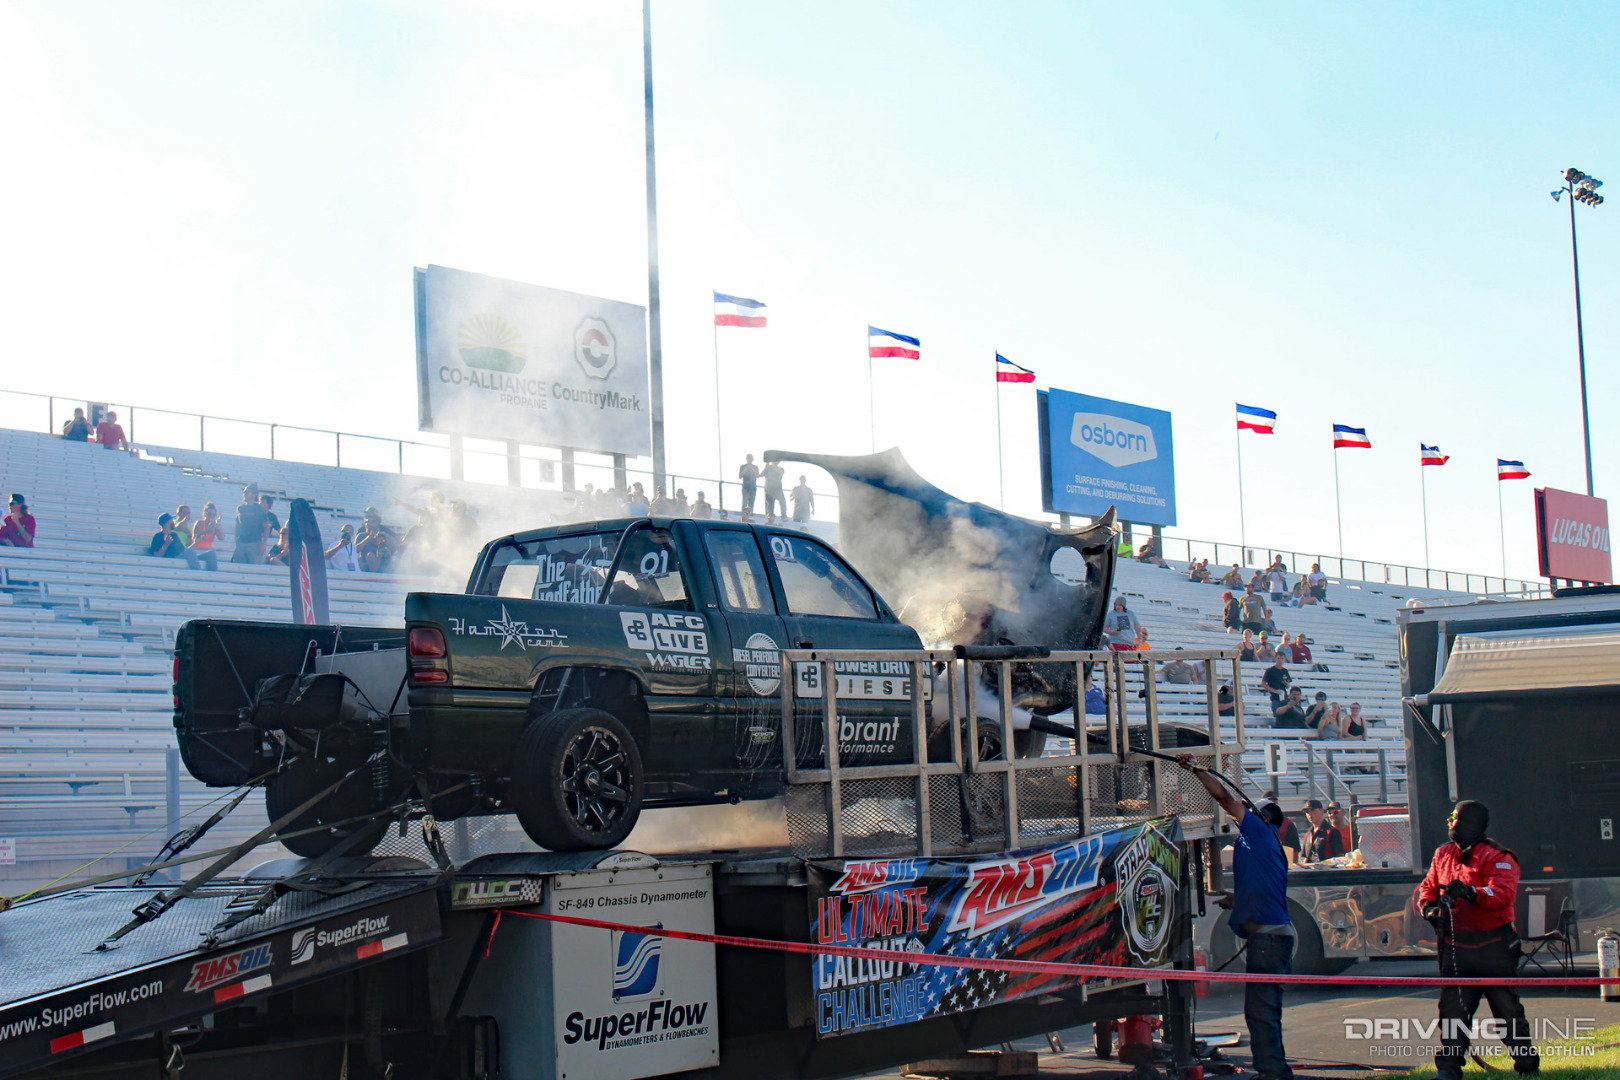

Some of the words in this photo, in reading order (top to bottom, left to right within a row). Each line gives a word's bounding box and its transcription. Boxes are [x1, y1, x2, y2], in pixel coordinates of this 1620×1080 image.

[439, 365, 547, 398] CO-ALLIANCE
[552, 382, 641, 411] CountryMark
[500, 393, 548, 410] PROPANE
[1081, 422, 1147, 453] osborn
[1066, 484, 1092, 497] CUTTING,
[1093, 489, 1104, 498] AND
[1105, 490, 1136, 502] DEBURRING
[1137, 495, 1166, 507] SOLUTIONS
[1075, 474, 1100, 487] SURFACE
[1101, 478, 1129, 492] FINISHING,
[1130, 483, 1158, 496] CLEANING,
[1551, 518, 1592, 548] LUCAS
[1592, 526, 1609, 552] OIL
[536, 554, 566, 584] The
[448, 617, 568, 639] Hamton
[651, 612, 704, 630] AFC
[527, 639, 569, 648] cams
[657, 632, 704, 651] LIVE
[645, 653, 711, 670] WAGLER
[834, 661, 878, 674] OWER
[880, 661, 931, 675] DRIVN
[1119, 836, 1149, 888] STRAP
[1147, 831, 1178, 882] DOWN
[829, 859, 918, 896] AMSOIL
[947, 834, 1103, 939] AMSOIL
[558, 897, 594, 911] SF-849
[598, 894, 637, 907] Chassis
[641, 889, 708, 905] Dynamometer
[818, 886, 929, 944] ULTIMATE
[317, 916, 389, 947] SuperFlow
[183, 942, 274, 993] AMSOIL
[818, 936, 907, 990] CALLOUT
[0, 979, 163, 1041] www.SuperFlow.com
[818, 976, 927, 1034] CHALLENGE
[564, 1000, 709, 1051] SuperFlow
[606, 1034, 658, 1050] DYNAMOMETERS
[659, 1033, 664, 1042] &
[665, 1026, 709, 1041] FLOWBENCHES
